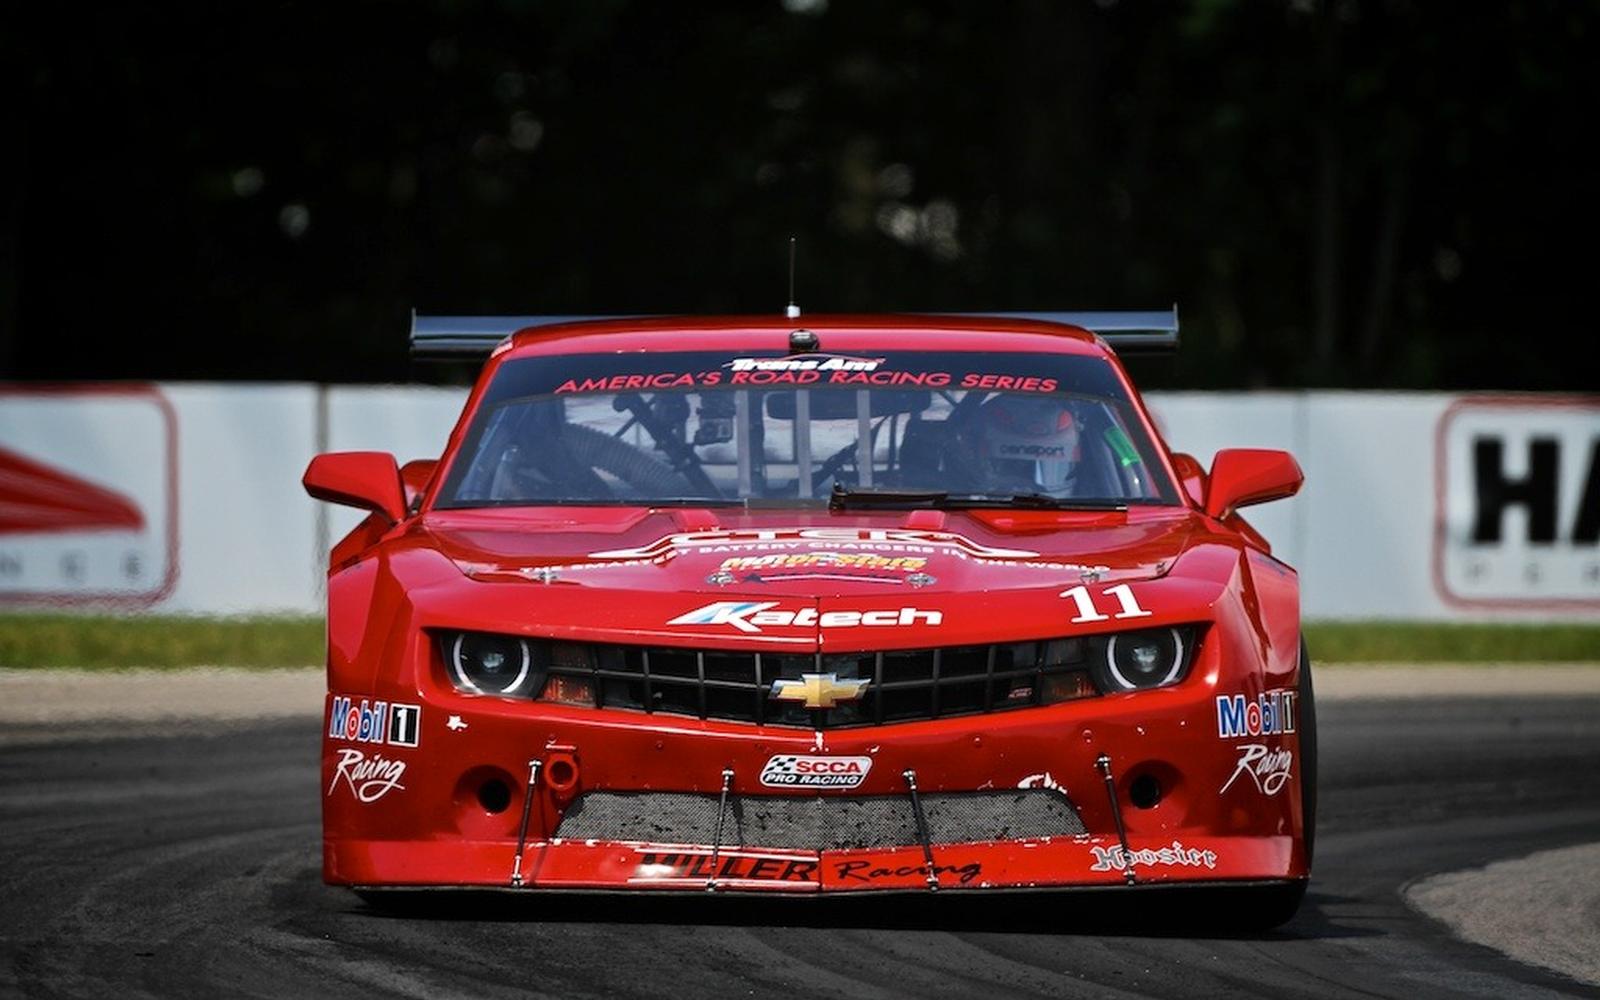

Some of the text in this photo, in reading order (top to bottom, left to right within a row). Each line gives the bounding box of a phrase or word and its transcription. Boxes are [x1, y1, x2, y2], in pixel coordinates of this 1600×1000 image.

[554, 371, 1058, 394] AMERICA'S ROAD RACING SERIES
[699, 543, 799, 553] BATTERY
[808, 542, 934, 554] CHARGERS
[942, 548, 967, 560] IN
[666, 601, 943, 633] Katech
[1059, 583, 1153, 623] 11
[329, 696, 388, 744] Mobil
[1216, 692, 1282, 739] Mobil
[327, 748, 406, 802] Racing
[764, 773, 859, 785] PRO RACING
[796, 760, 861, 773] SCCA
[1219, 743, 1292, 796] Racing
[833, 860, 981, 884] Racing
